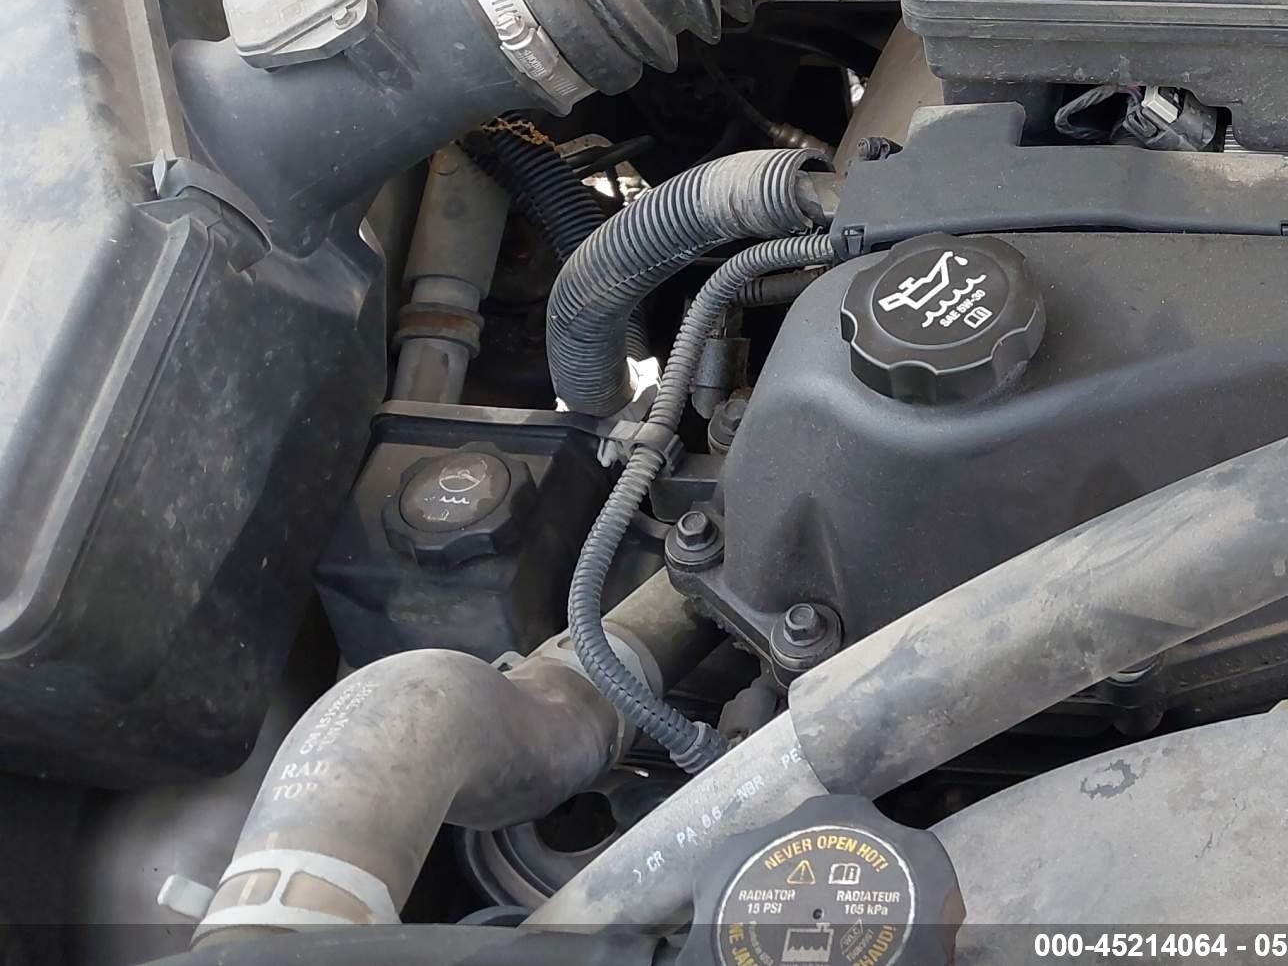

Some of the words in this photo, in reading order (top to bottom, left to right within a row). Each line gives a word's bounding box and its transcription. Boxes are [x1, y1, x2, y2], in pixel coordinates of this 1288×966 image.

[939, 309, 961, 327] SAE
[956, 289, 987, 314] 5W-30
[646, 850, 666, 872] CR
[676, 827, 697, 847] PA
[780, 744, 802, 769] PE
[764, 837, 813, 870] NEVER
[817, 835, 856, 852] OPEN
[854, 840, 890, 872] HOT!
[738, 889, 796, 901] RADIATOR
[836, 890, 901, 902] RADIATEUR
[747, 904, 760, 914] 15
[763, 904, 783, 914] PSI
[844, 904, 864, 915] 105
[867, 904, 889, 916] kPa
[852, 924, 897, 966] HAUD!
